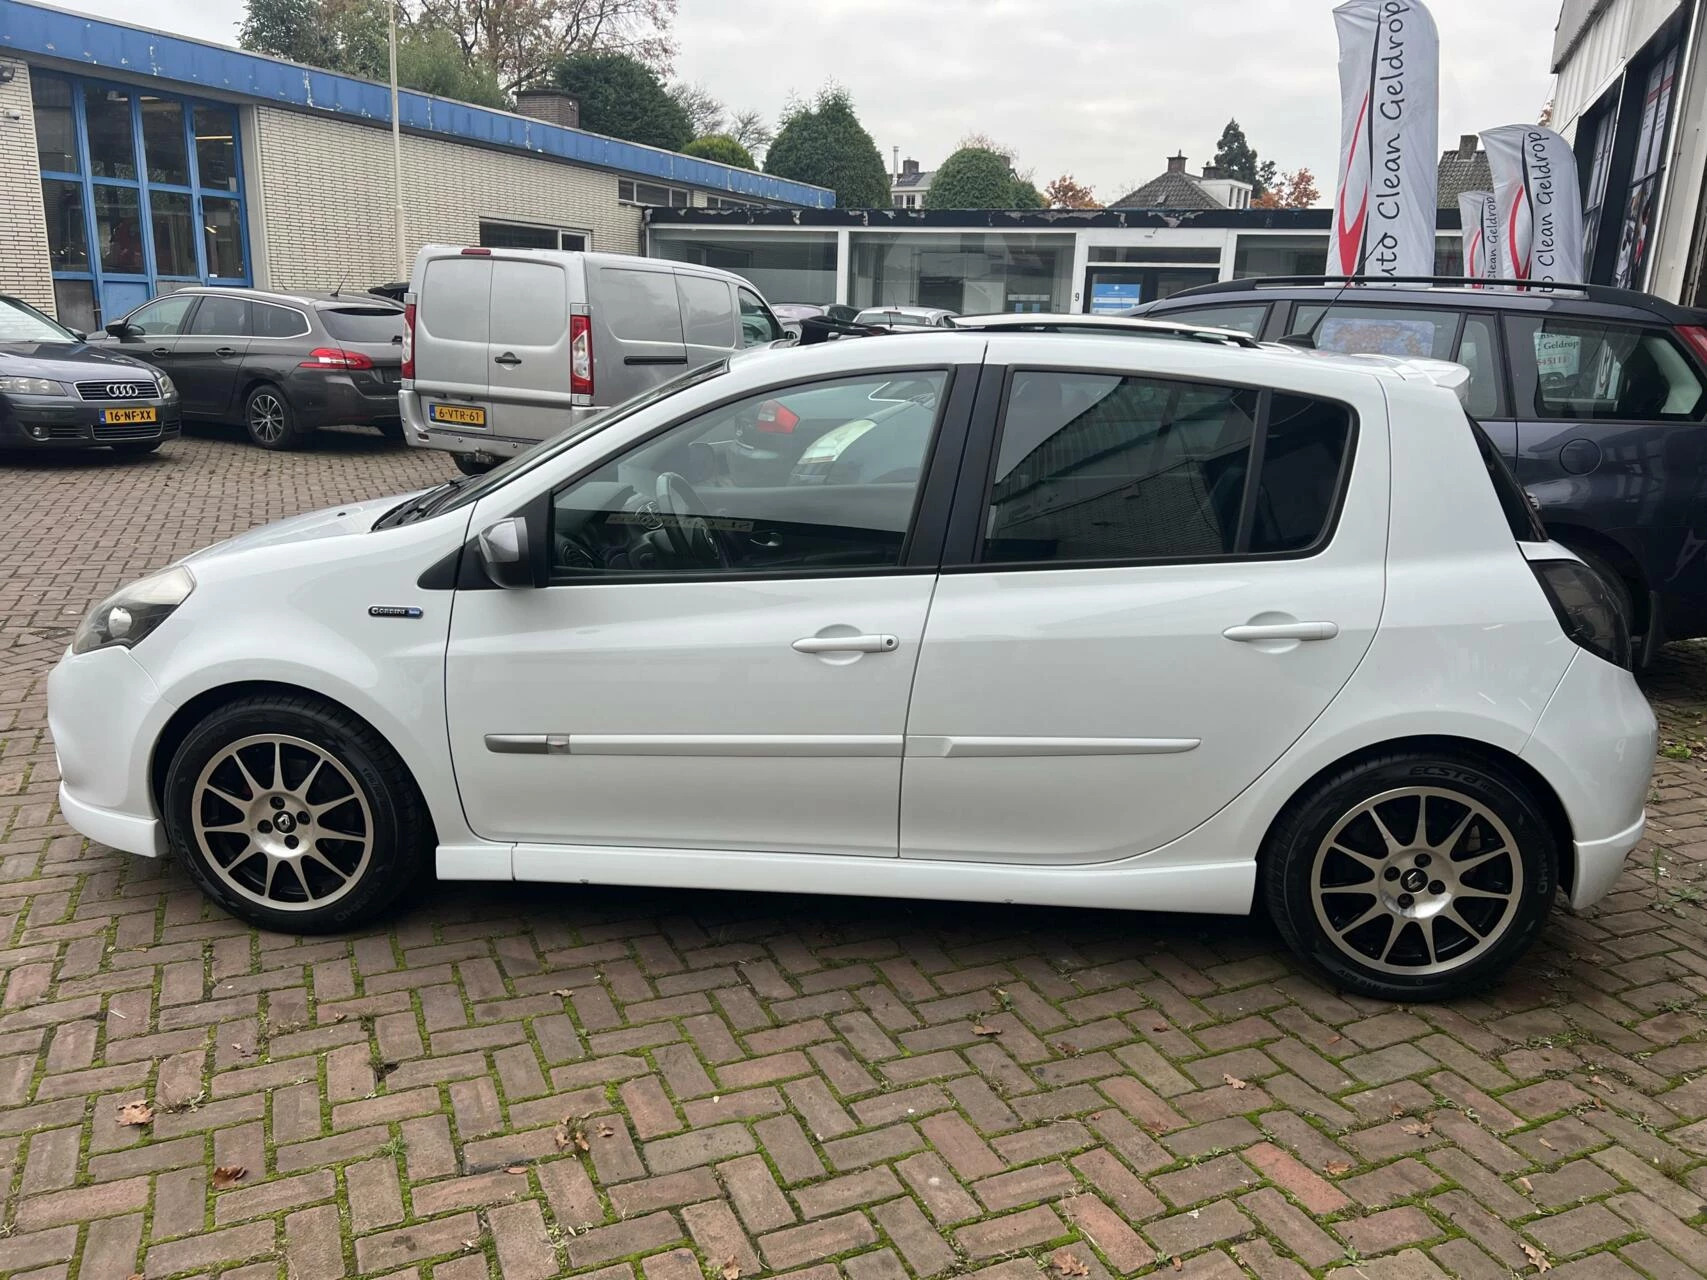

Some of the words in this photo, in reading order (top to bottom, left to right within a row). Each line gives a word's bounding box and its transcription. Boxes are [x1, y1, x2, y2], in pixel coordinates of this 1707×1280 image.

[1379, 1, 1410, 120] Geldrop
[1376, 133, 1400, 220] Clean
[1528, 131, 1554, 205] Geldrop
[1535, 212, 1555, 267] Clean
[1075, 292, 1080, 301] 9
[109, 410, 152, 422] 16-NF-XX
[439, 408, 480, 422] 6-VTR-61
